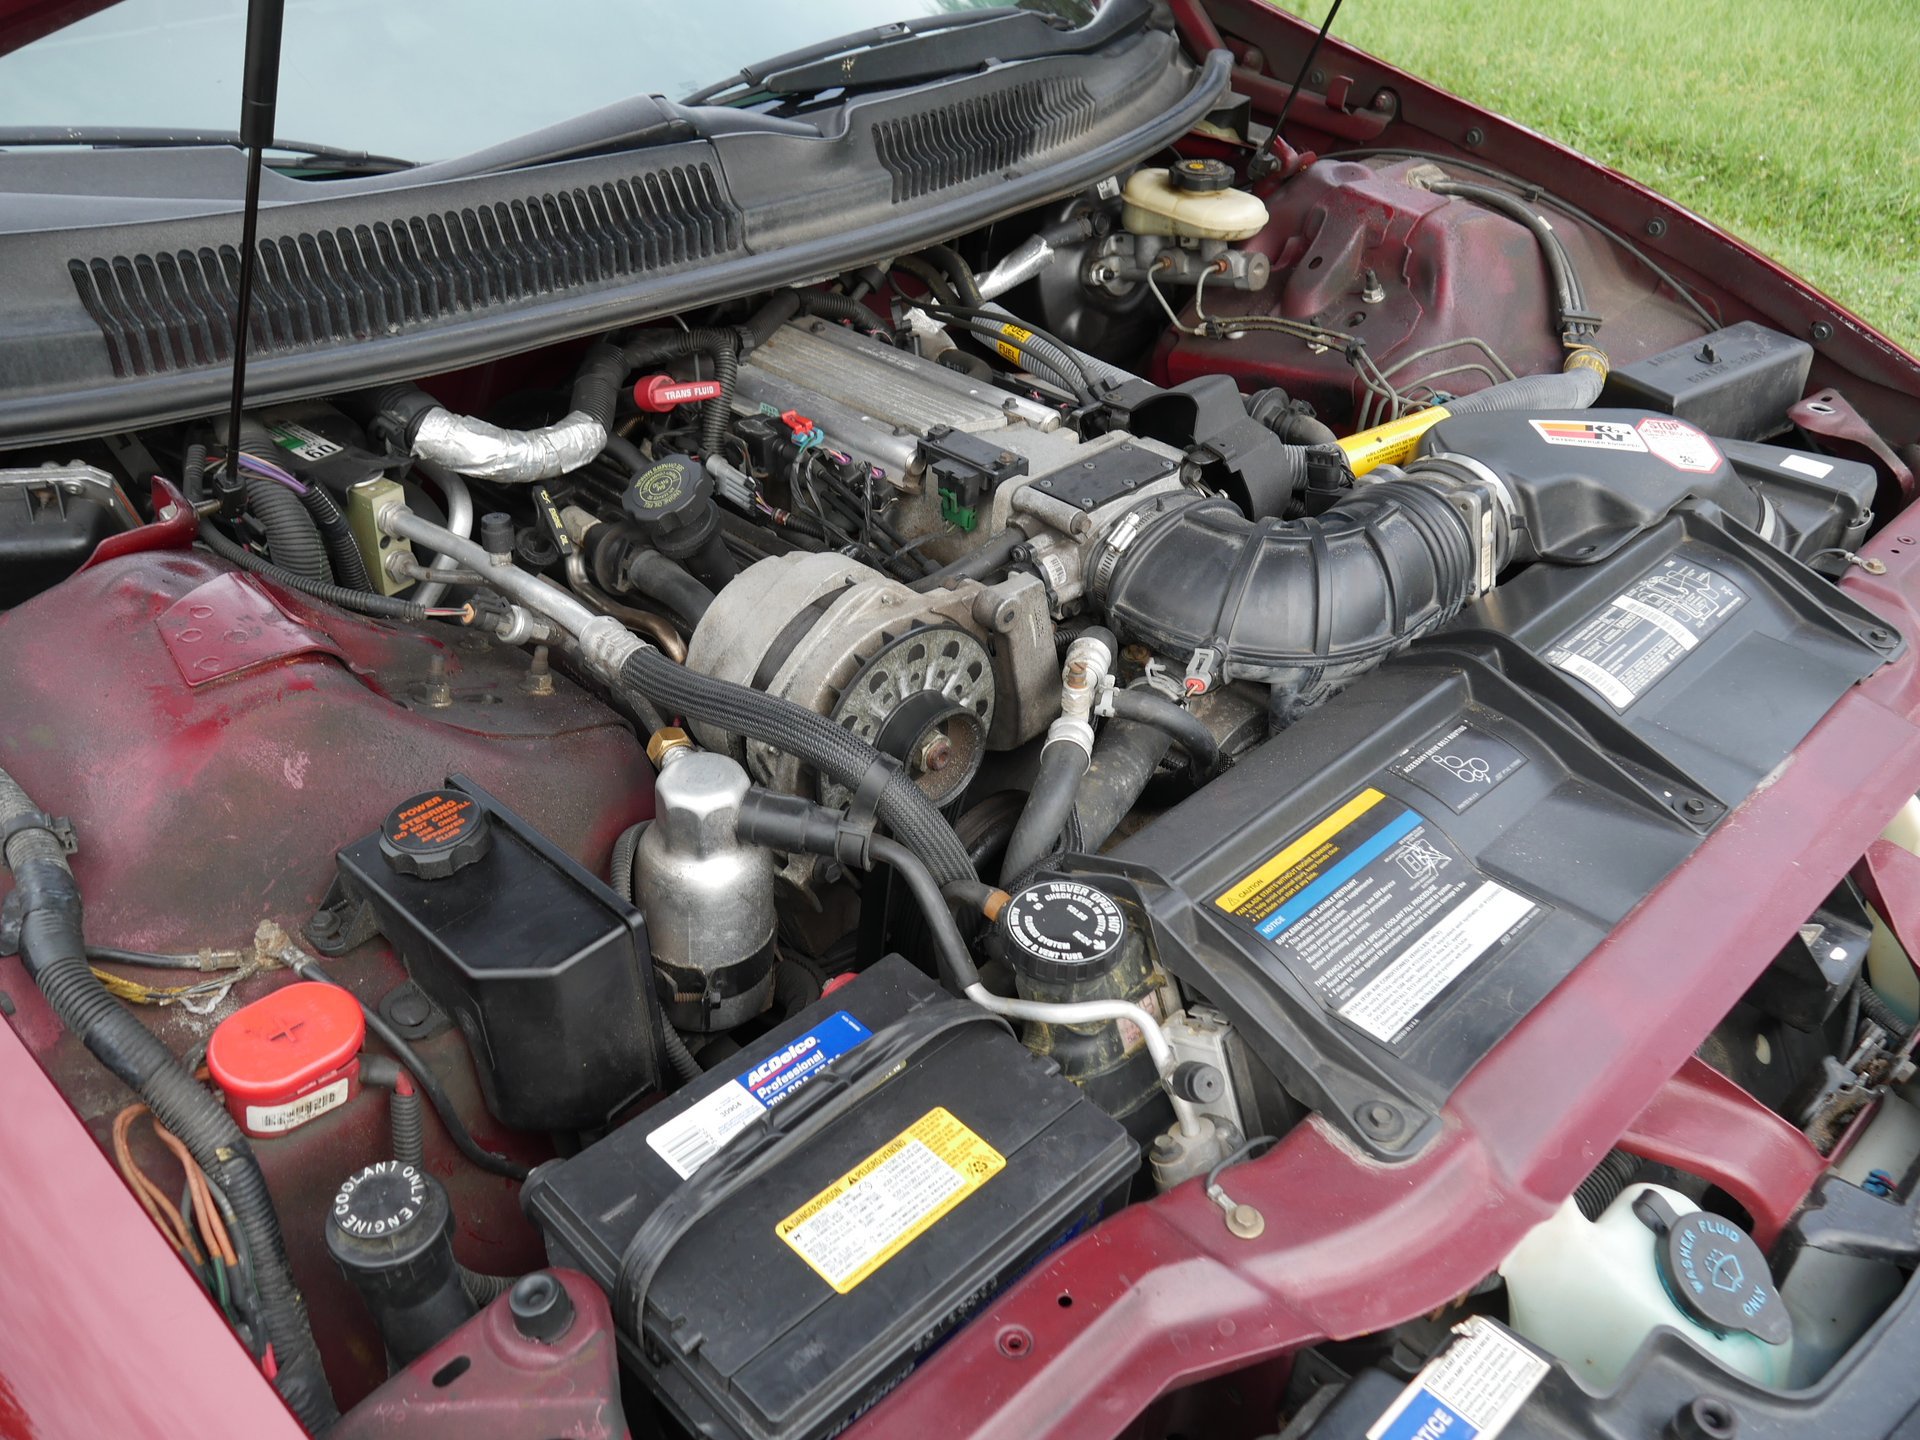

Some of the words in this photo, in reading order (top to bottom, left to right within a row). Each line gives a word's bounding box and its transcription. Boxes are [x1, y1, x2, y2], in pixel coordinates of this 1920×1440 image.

[998, 343, 1016, 359] FUEL
[665, 388, 692, 400] TRANS
[694, 386, 714, 396] FLUID
[1647, 420, 1680, 430] STOP
[398, 795, 442, 820] POWER
[398, 799, 458, 831] STEERING
[393, 830, 408, 841] DO
[409, 821, 428, 833] NOT
[431, 800, 472, 822] OVERFILL
[415, 826, 435, 837] USE
[437, 813, 459, 827] ONLY
[421, 818, 466, 843] APPROVED
[435, 827, 461, 843] FLUID
[1044, 892, 1072, 902] CHECK
[1236, 878, 1264, 899] CAUTION
[1050, 884, 1090, 897] NEVER
[1089, 892, 1117, 914] OPEN
[1107, 915, 1120, 935] HOT
[1072, 894, 1095, 909] LEVEL
[1091, 906, 1103, 915] IN
[1093, 914, 1107, 937] BOTTLE
[1260, 914, 1286, 934] NOTICE
[1274, 914, 1312, 946] SUPPLEMENTAL
[1308, 895, 1336, 919] INFLATABLE
[1037, 935, 1071, 950] SYSTEM
[1038, 946, 1061, 959] VENT
[1060, 952, 1084, 960] TUBE
[1324, 960, 1345, 978] VEHICLE
[1383, 909, 1405, 929] COOLANT
[748, 1035, 818, 1088] ACDelco
[756, 1050, 825, 1100] Professional
[335, 1159, 399, 1216] COOLANT
[402, 1165, 425, 1205] ONLY
[341, 1206, 414, 1234] ENGINE
[1679, 1228, 1705, 1294] WASHER
[1698, 1220, 1741, 1243] FLUID
[1742, 1284, 1768, 1318] ONLY
[1411, 1408, 1454, 1440] TICE
